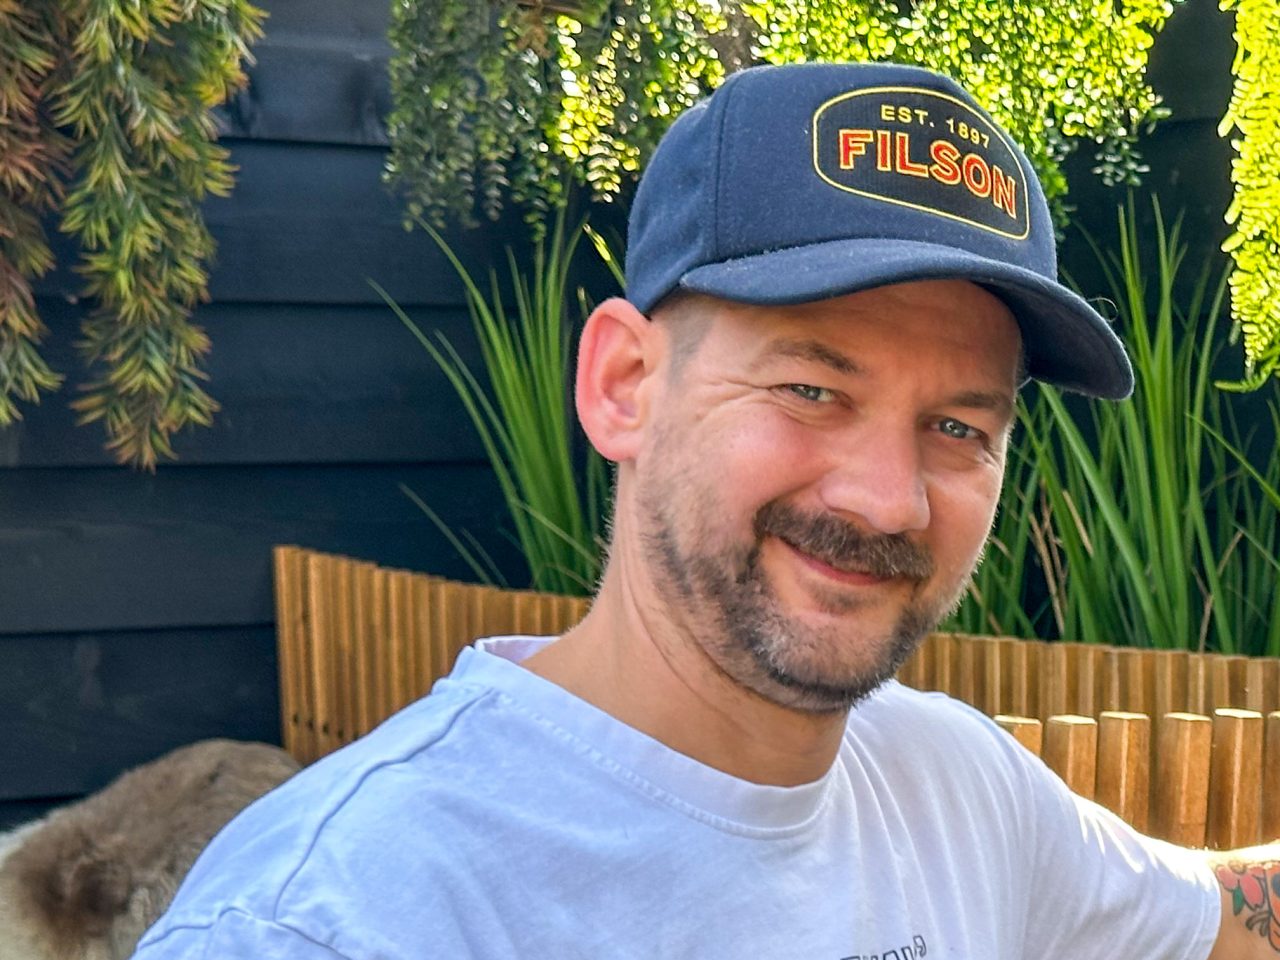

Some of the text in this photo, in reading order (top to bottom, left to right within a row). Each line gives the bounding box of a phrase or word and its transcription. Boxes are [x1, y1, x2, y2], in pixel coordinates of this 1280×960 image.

[880, 104, 990, 149] EST. 1897
[838, 128, 1017, 220] FILSON
